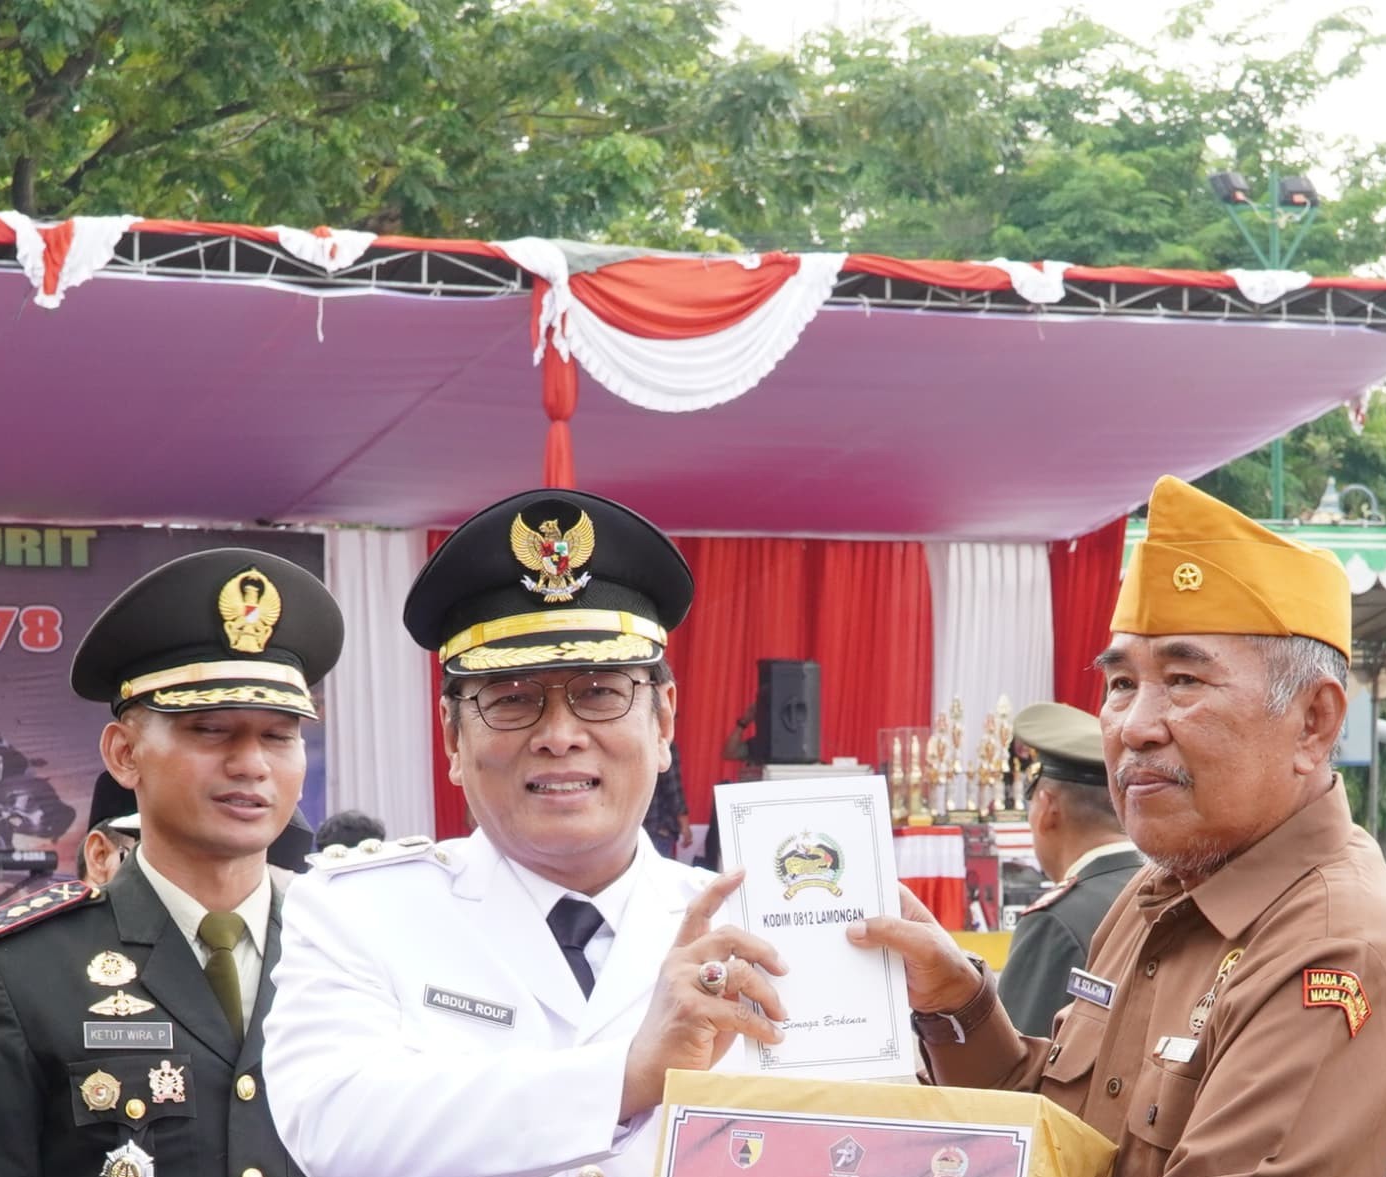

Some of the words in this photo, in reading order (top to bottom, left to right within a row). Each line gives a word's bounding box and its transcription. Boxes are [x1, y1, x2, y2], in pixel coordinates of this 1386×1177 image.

[763, 912, 791, 928] KODIM
[793, 911, 814, 926] 0812
[815, 907, 865, 925] LAMONGAN
[433, 993, 473, 1012] ABDUL
[475, 1003, 508, 1020] ROUF
[90, 1029, 124, 1041] KETUT
